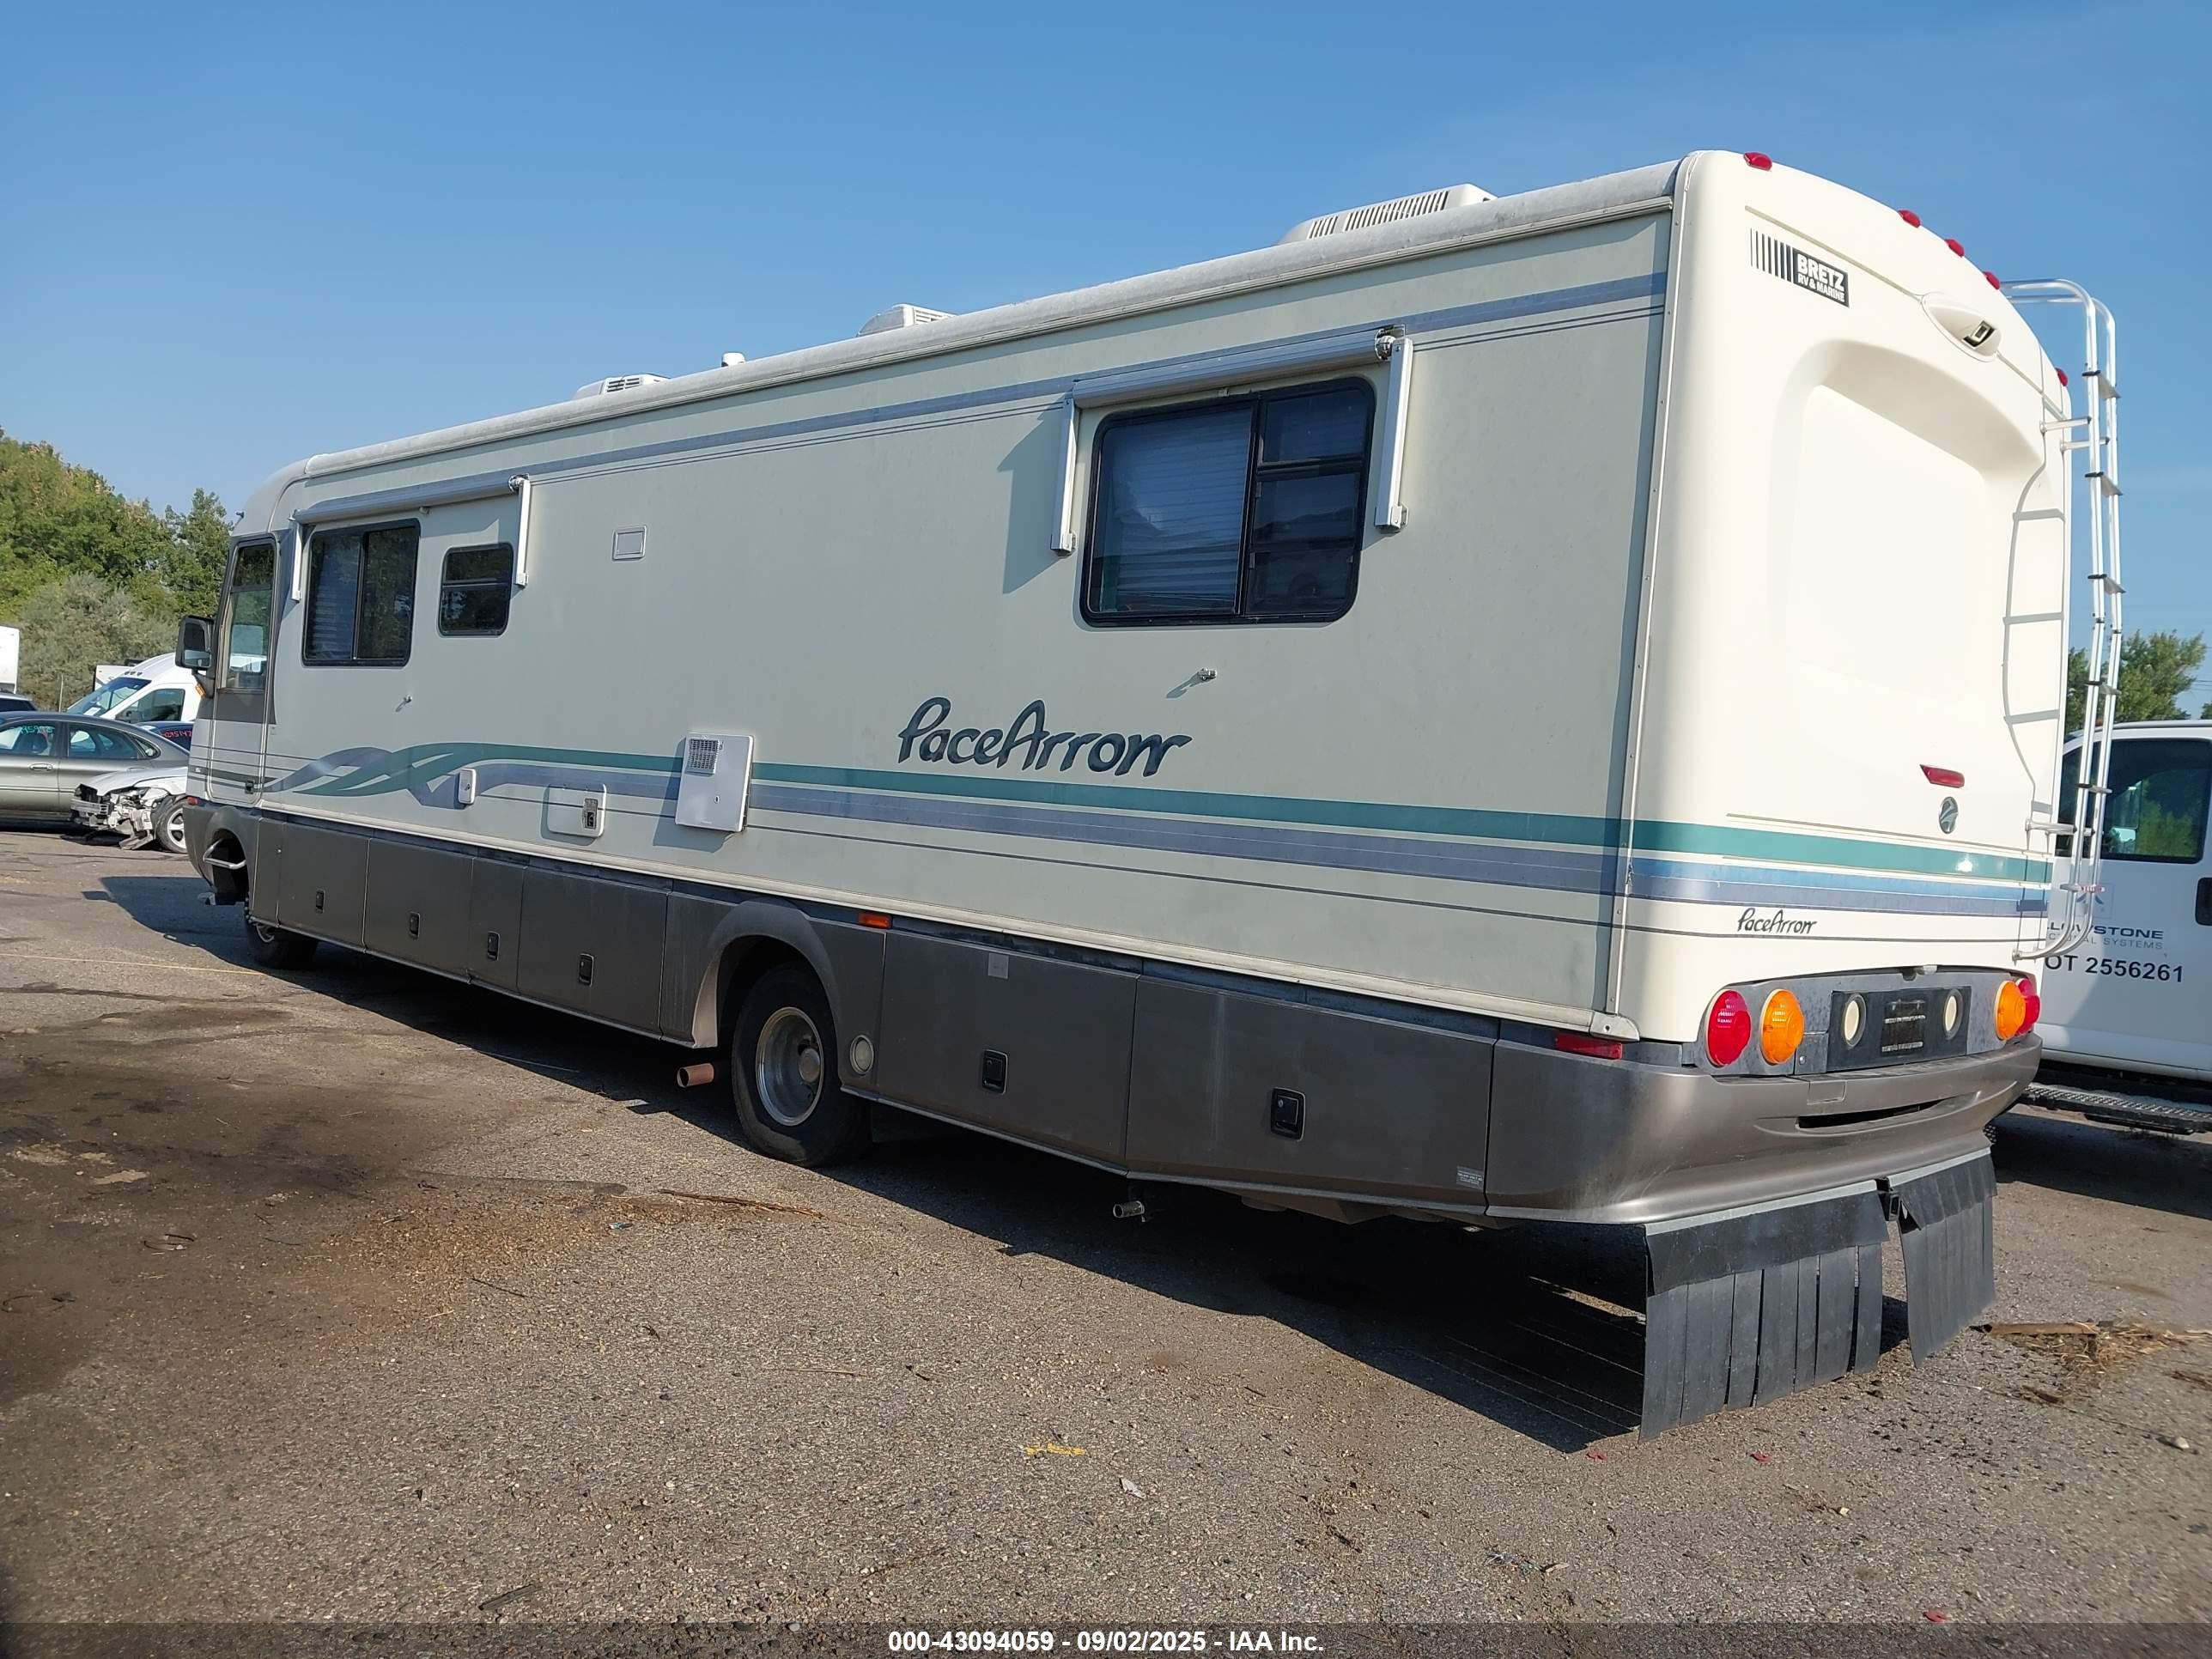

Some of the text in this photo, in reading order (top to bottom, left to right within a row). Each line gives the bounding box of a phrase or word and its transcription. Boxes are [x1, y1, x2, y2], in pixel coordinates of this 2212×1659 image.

[1797, 253, 1844, 293] BRETZ
[1797, 272, 1845, 303] RV & MARINE
[2104, 937, 2163, 950] SYSTEMS
[2085, 957, 2184, 983] 2556261
